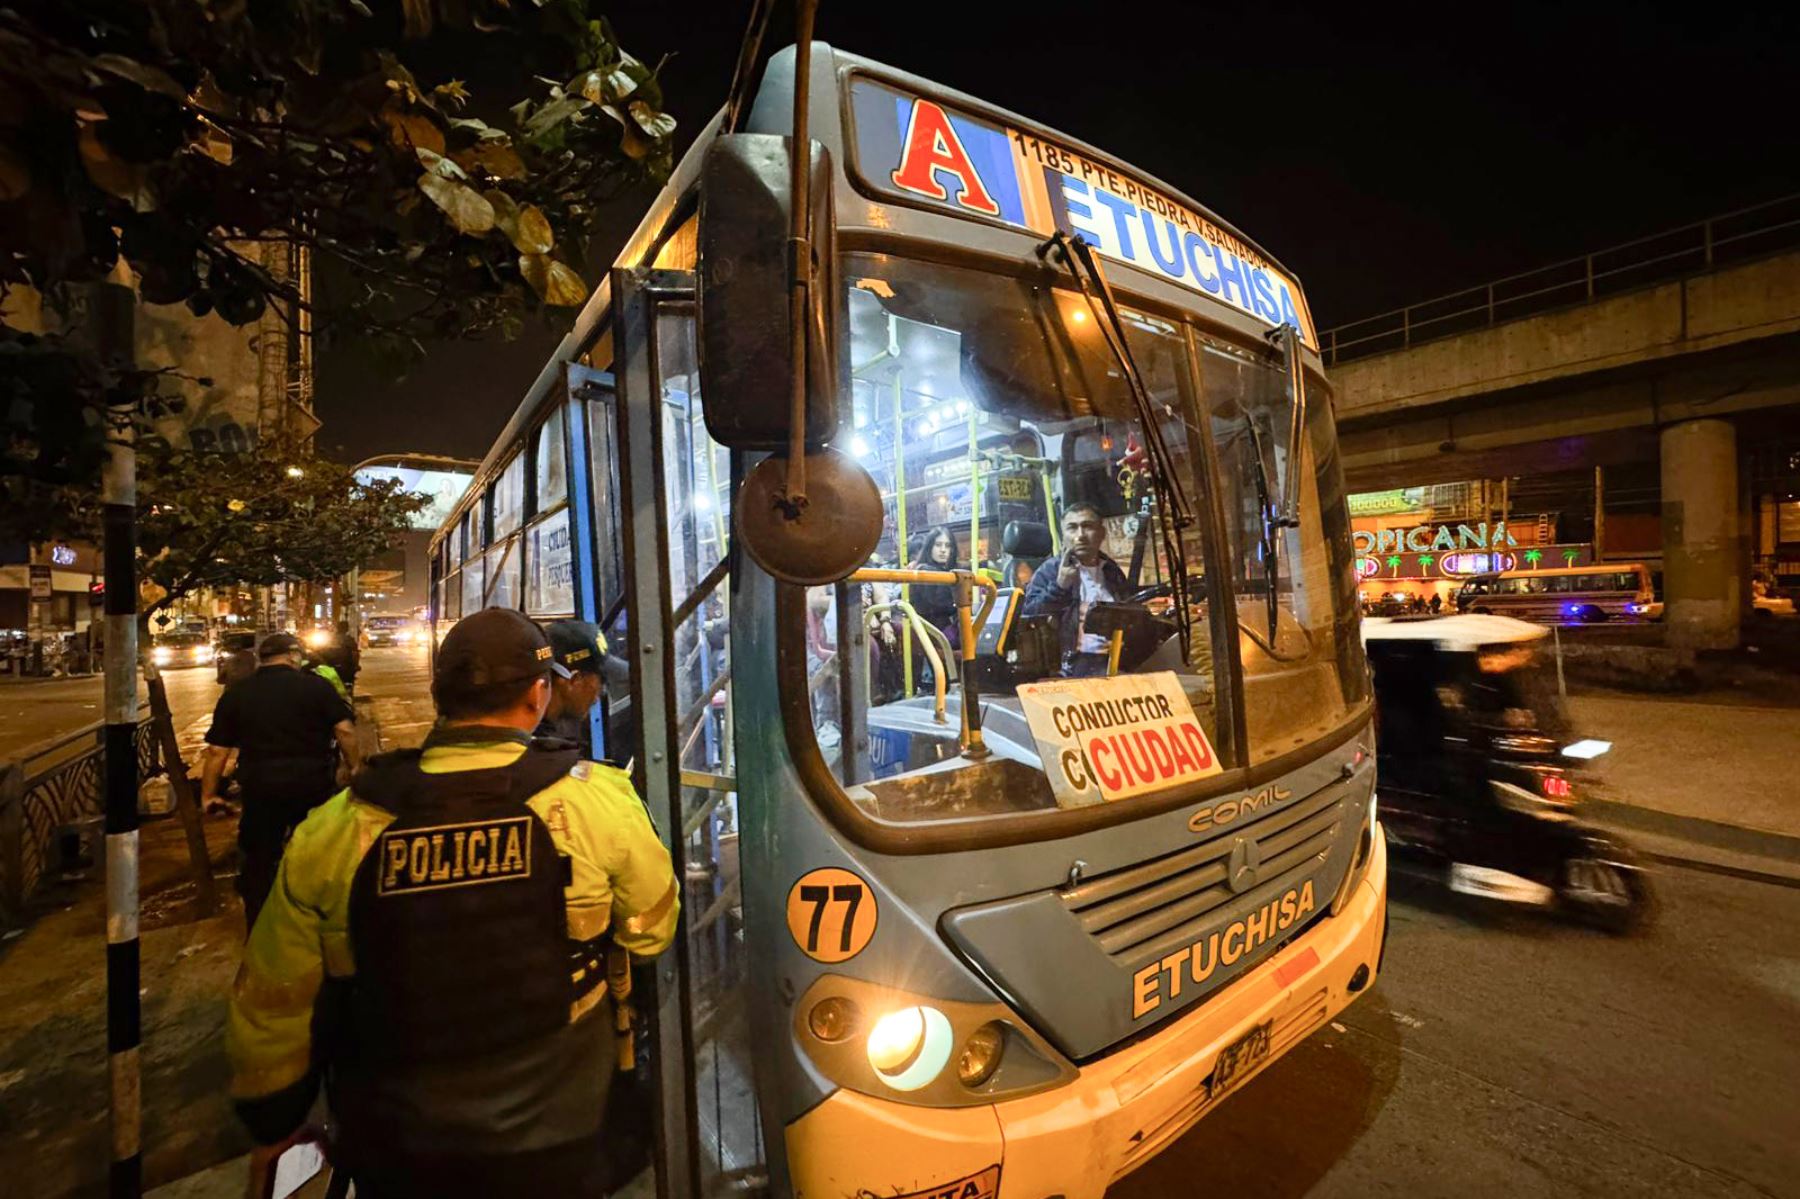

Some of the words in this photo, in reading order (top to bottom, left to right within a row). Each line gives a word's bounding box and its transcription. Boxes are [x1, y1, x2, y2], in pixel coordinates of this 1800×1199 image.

[891, 98, 1001, 216] A
[1015, 133, 1075, 174] 1185
[1080, 159, 1191, 230] PTE.PIEDRA
[1058, 173, 1306, 340] ETUCHISA
[1052, 694, 1173, 738] CONDUCTOR
[1089, 722, 1213, 792] CIUDAD
[1188, 784, 1291, 832] COMIL
[384, 826, 524, 888] POLICIA
[800, 884, 863, 952] 77
[1133, 878, 1315, 1020] ETUCHISA
